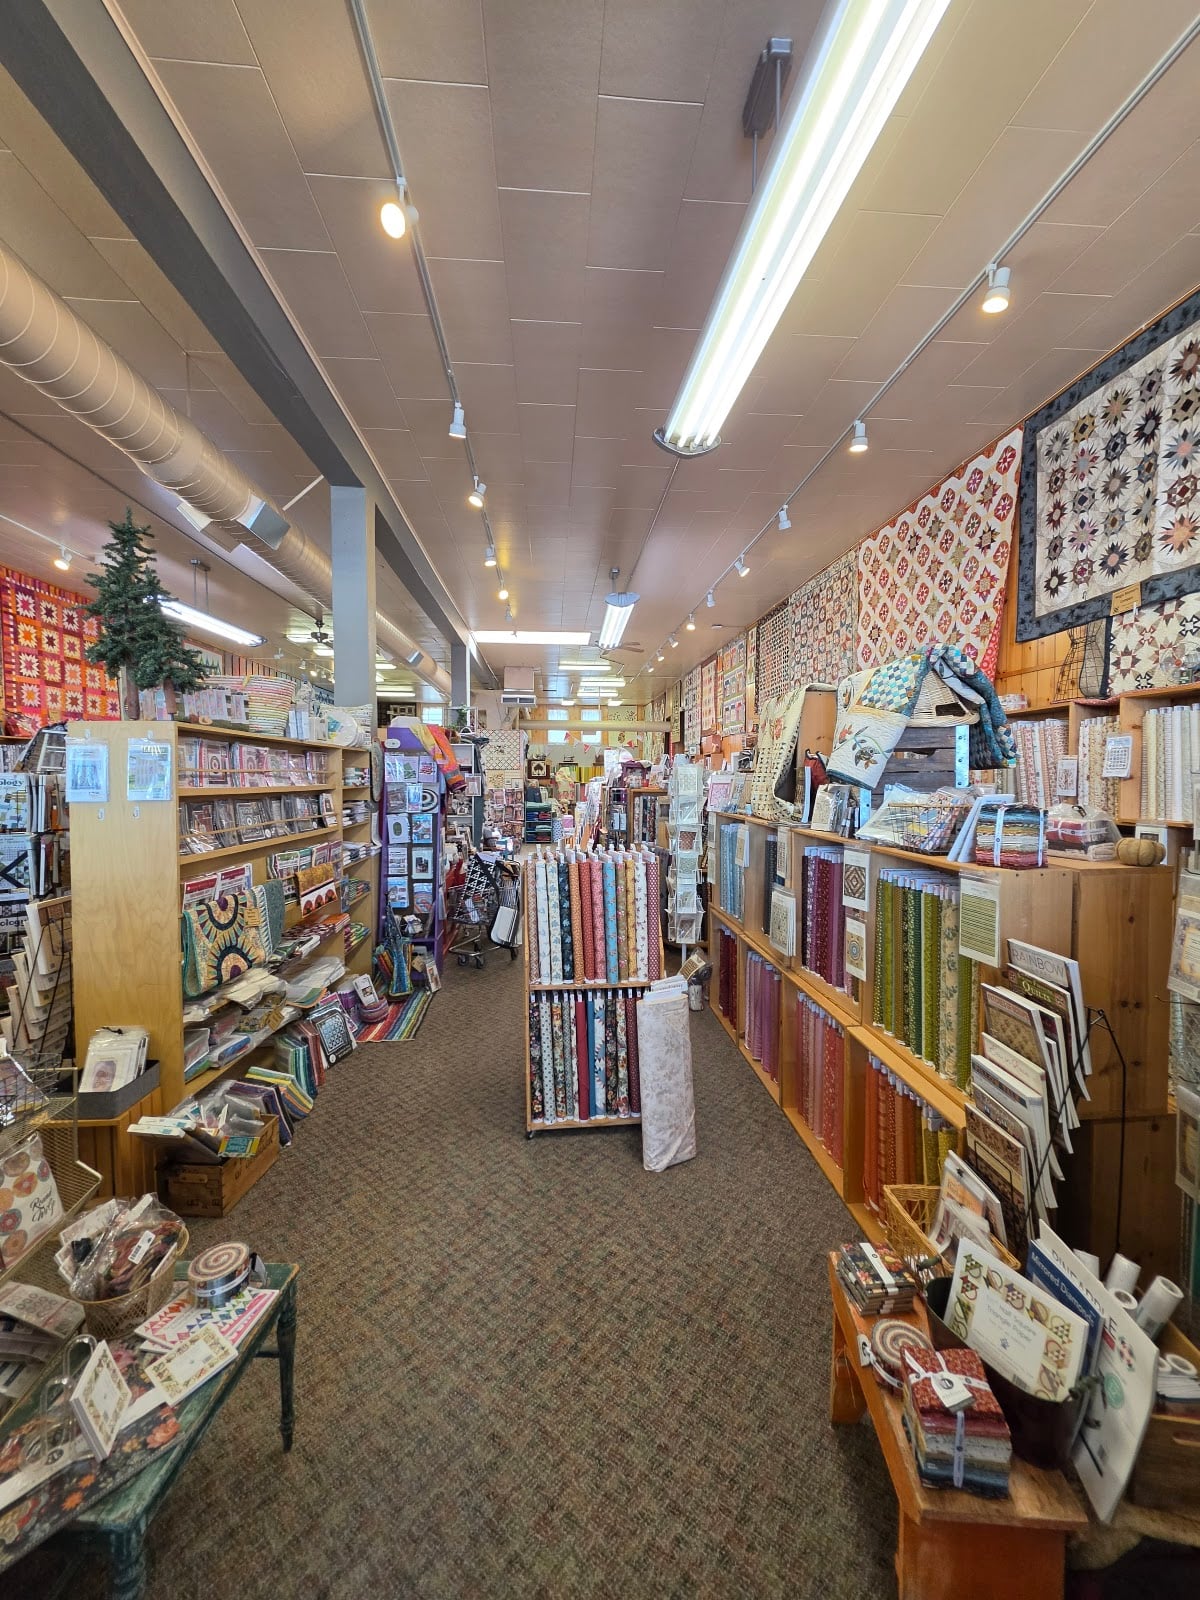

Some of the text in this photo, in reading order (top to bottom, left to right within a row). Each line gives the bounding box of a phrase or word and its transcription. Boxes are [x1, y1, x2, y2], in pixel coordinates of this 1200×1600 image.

[1012, 949, 1064, 978] RAINBOW
[1031, 1252, 1094, 1327] Mirrored Diamonds
